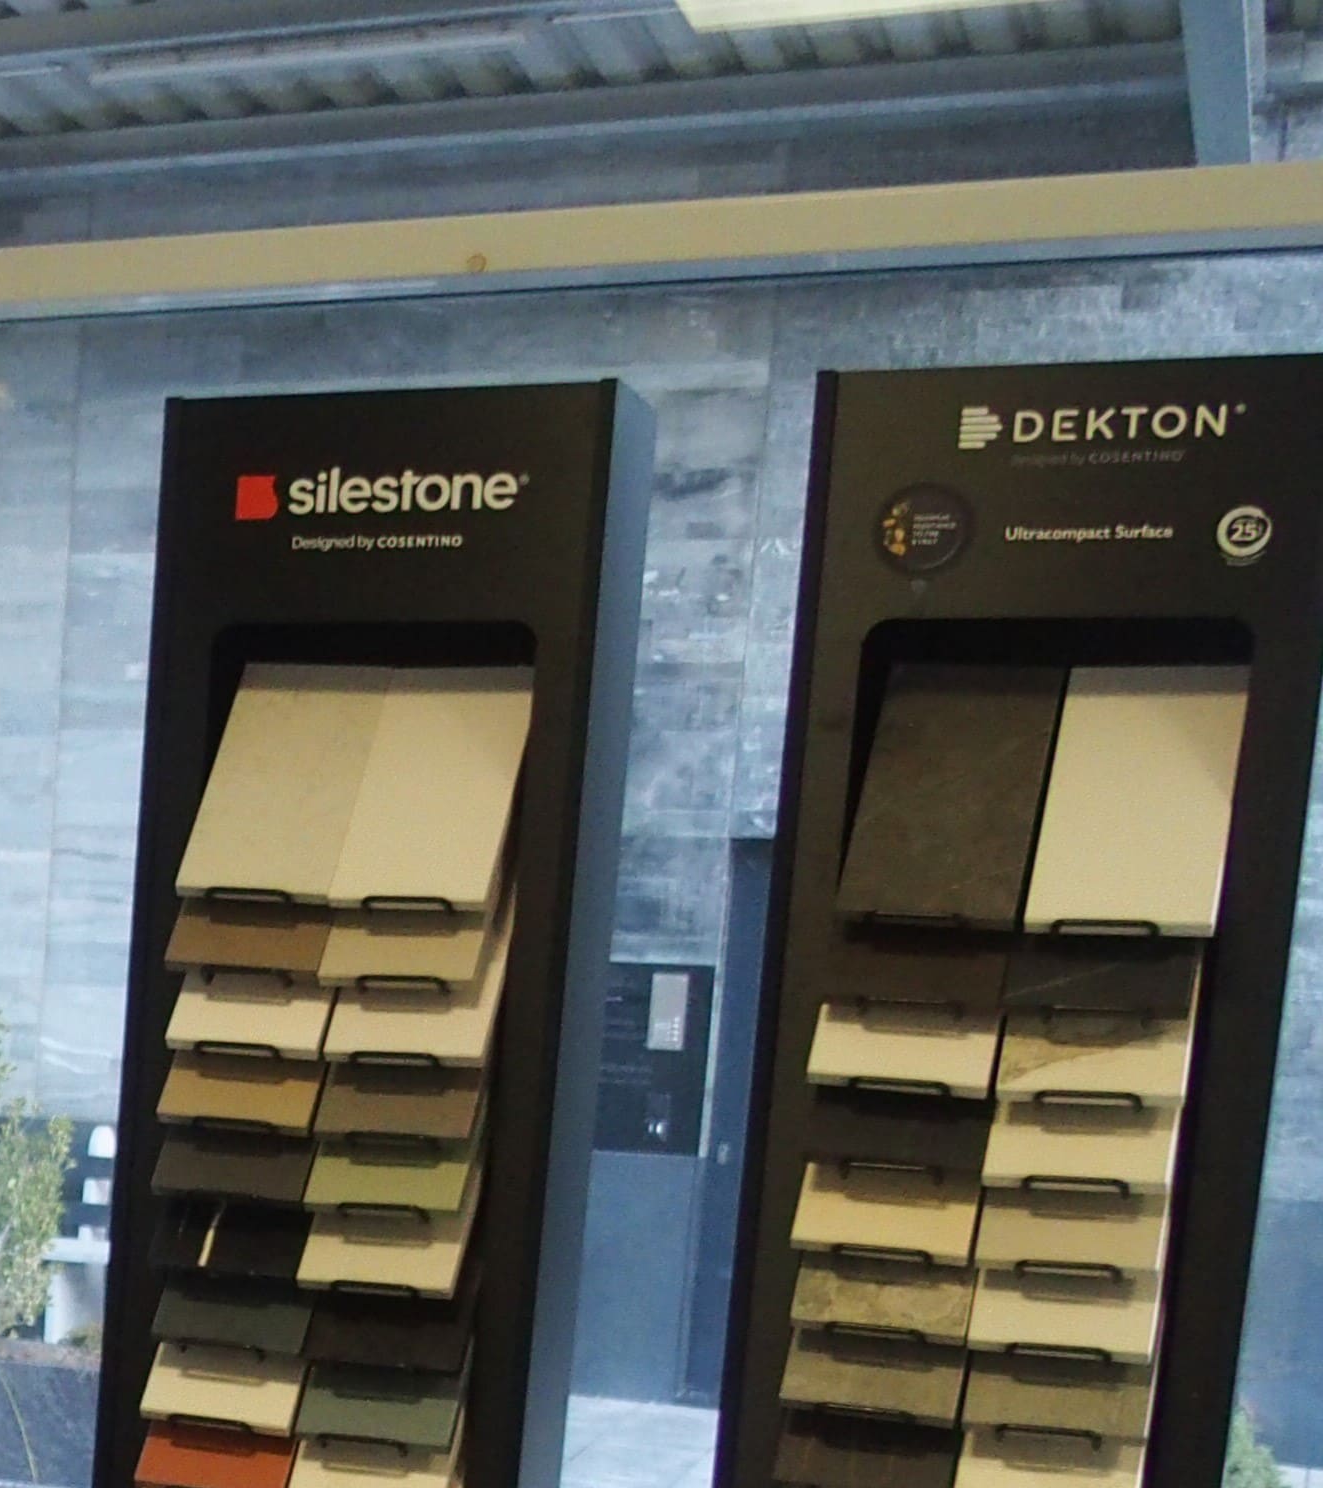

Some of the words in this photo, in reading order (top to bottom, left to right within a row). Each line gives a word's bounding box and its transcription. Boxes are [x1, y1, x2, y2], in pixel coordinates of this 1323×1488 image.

[1012, 403, 1228, 443] DEKTON
[1088, 450, 1184, 465] COSENTINO
[287, 466, 518, 515] silestone
[291, 535, 355, 552] Designed
[357, 535, 375, 551] by
[376, 534, 463, 549] COSENTINO
[1004, 525, 1111, 543] Ultracompact
[1114, 524, 1174, 541] Surface
